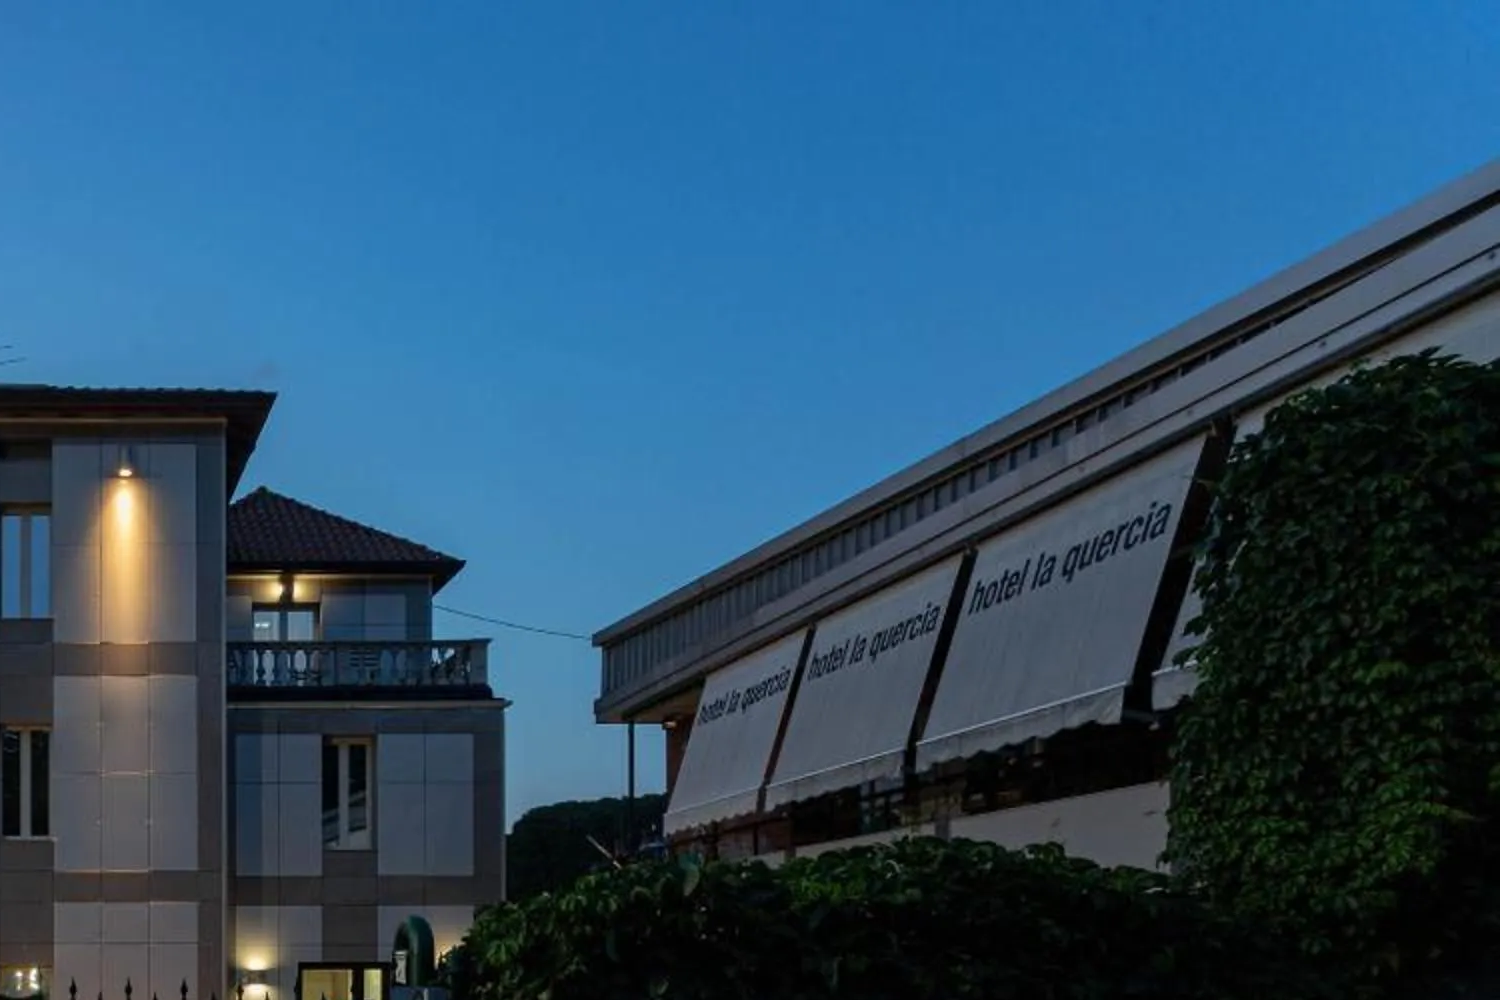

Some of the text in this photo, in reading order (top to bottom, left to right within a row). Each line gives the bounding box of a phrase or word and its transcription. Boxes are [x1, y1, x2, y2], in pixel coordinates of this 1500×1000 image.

[968, 501, 1172, 616] hotel la quercia
[807, 602, 941, 682] hotel la quercia
